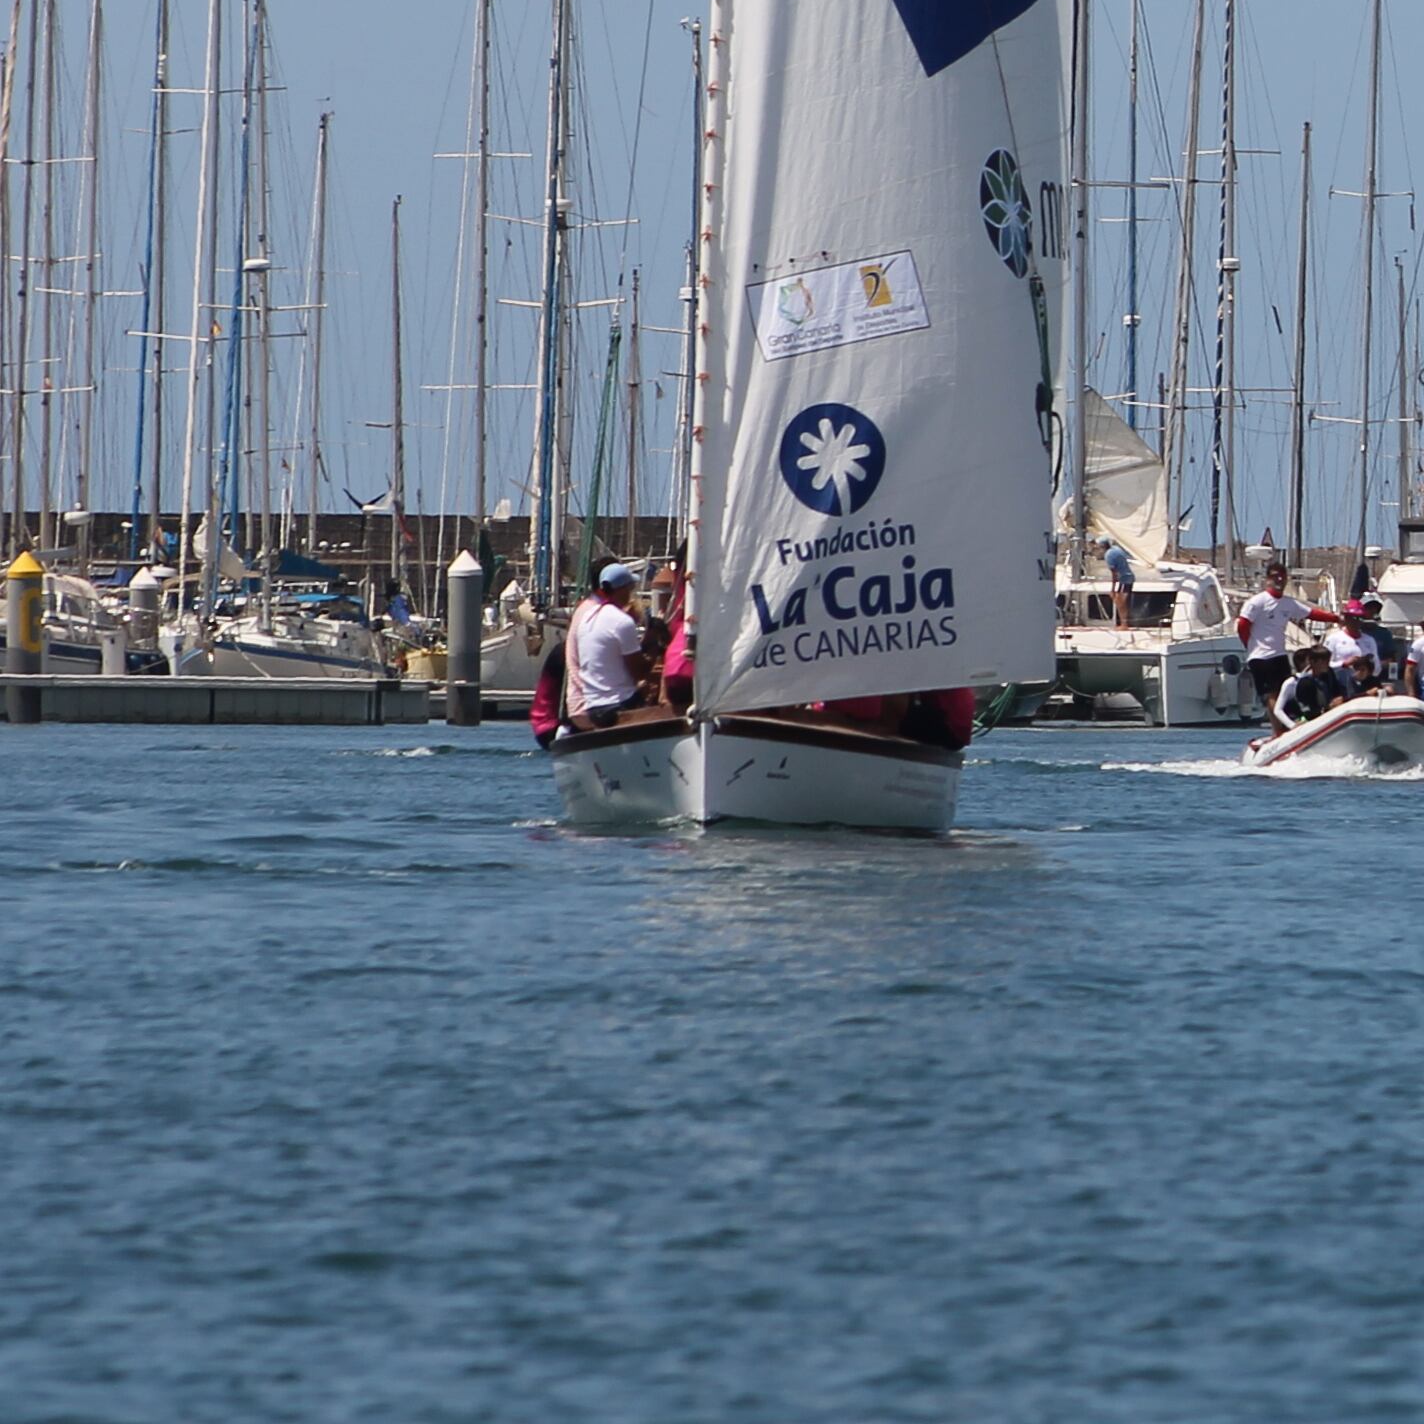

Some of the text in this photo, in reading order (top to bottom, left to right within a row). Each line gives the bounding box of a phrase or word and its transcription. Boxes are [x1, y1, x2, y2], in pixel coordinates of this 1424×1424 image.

[776, 517, 915, 566] Fundación
[753, 615, 958, 669] de CANARIAS
